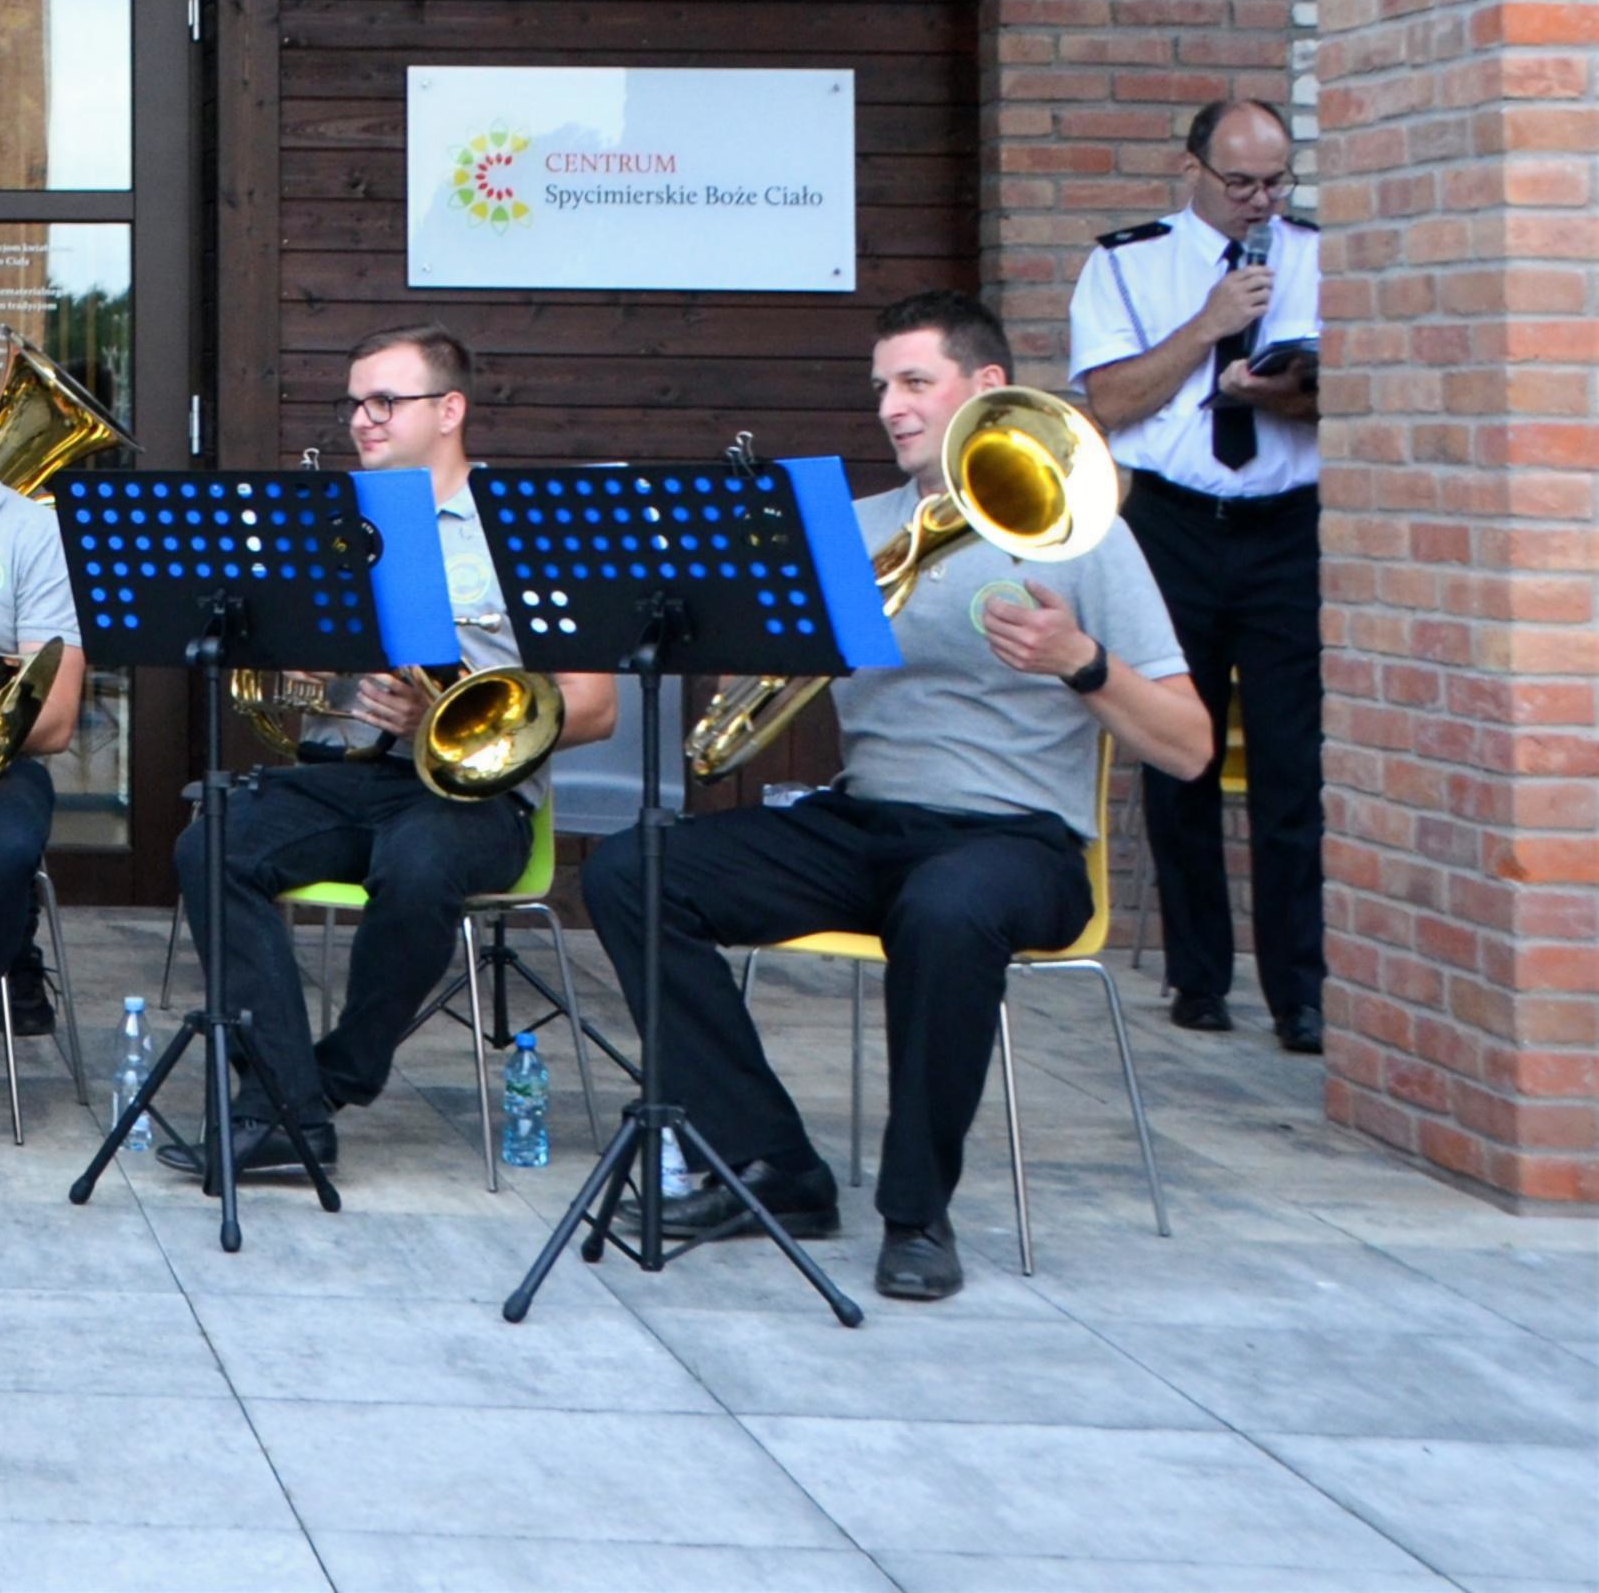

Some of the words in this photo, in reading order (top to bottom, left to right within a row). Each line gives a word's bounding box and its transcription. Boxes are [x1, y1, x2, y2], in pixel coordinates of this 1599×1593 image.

[545, 154, 677, 175] CENTRUM
[545, 184, 699, 211] Spycimierskie
[705, 186, 758, 206] Boże
[764, 186, 824, 207] Ciało
